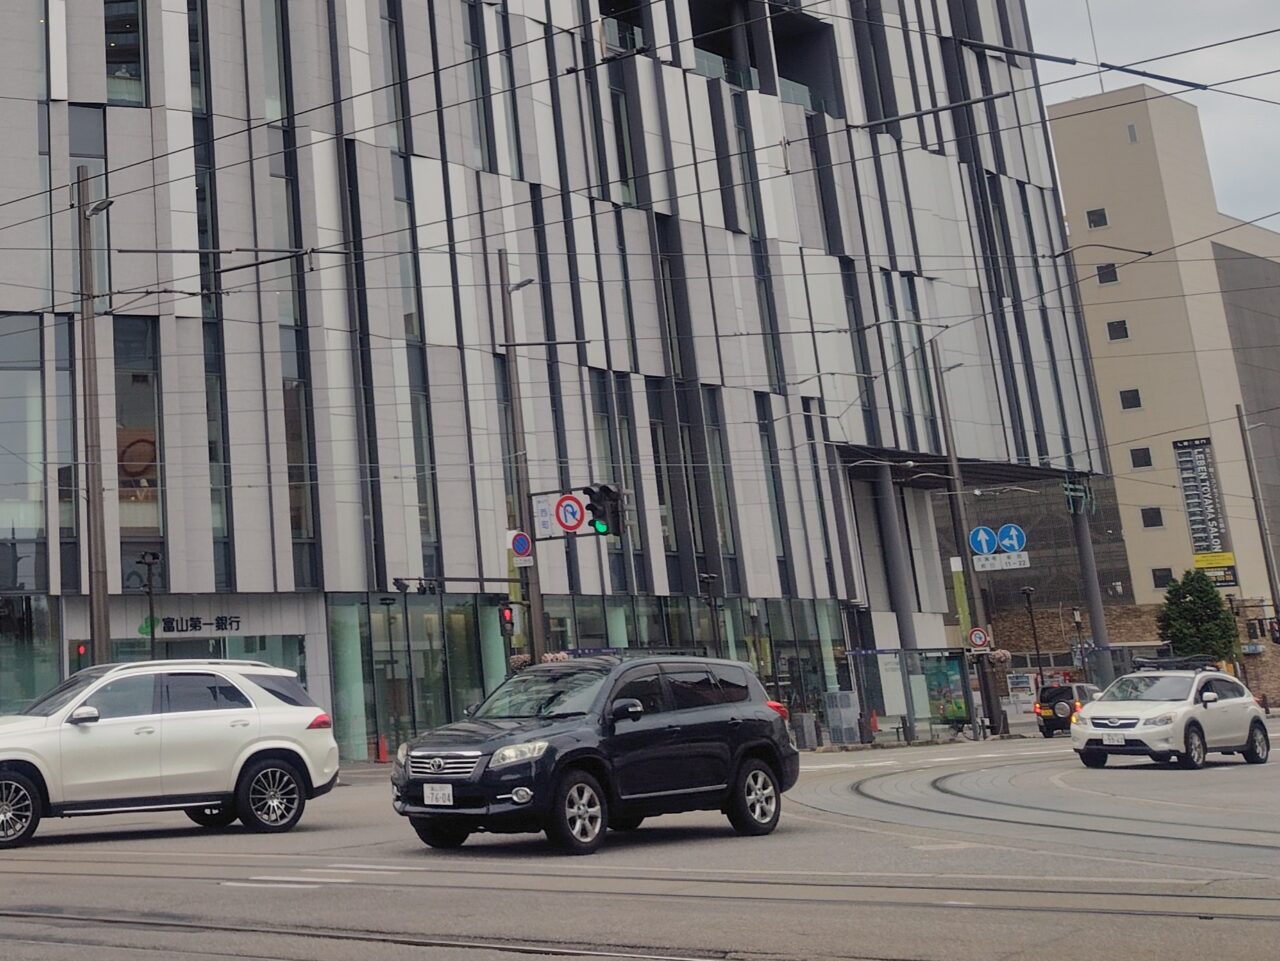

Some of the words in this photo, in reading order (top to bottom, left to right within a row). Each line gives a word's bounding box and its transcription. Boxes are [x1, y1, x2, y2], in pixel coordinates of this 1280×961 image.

[1194, 448, 1208, 479] LEBEN
[1201, 480, 1216, 519] TOYAMA
[1208, 520, 1222, 552] SALON
[161, 616, 240, 632] 富山第一銀行
